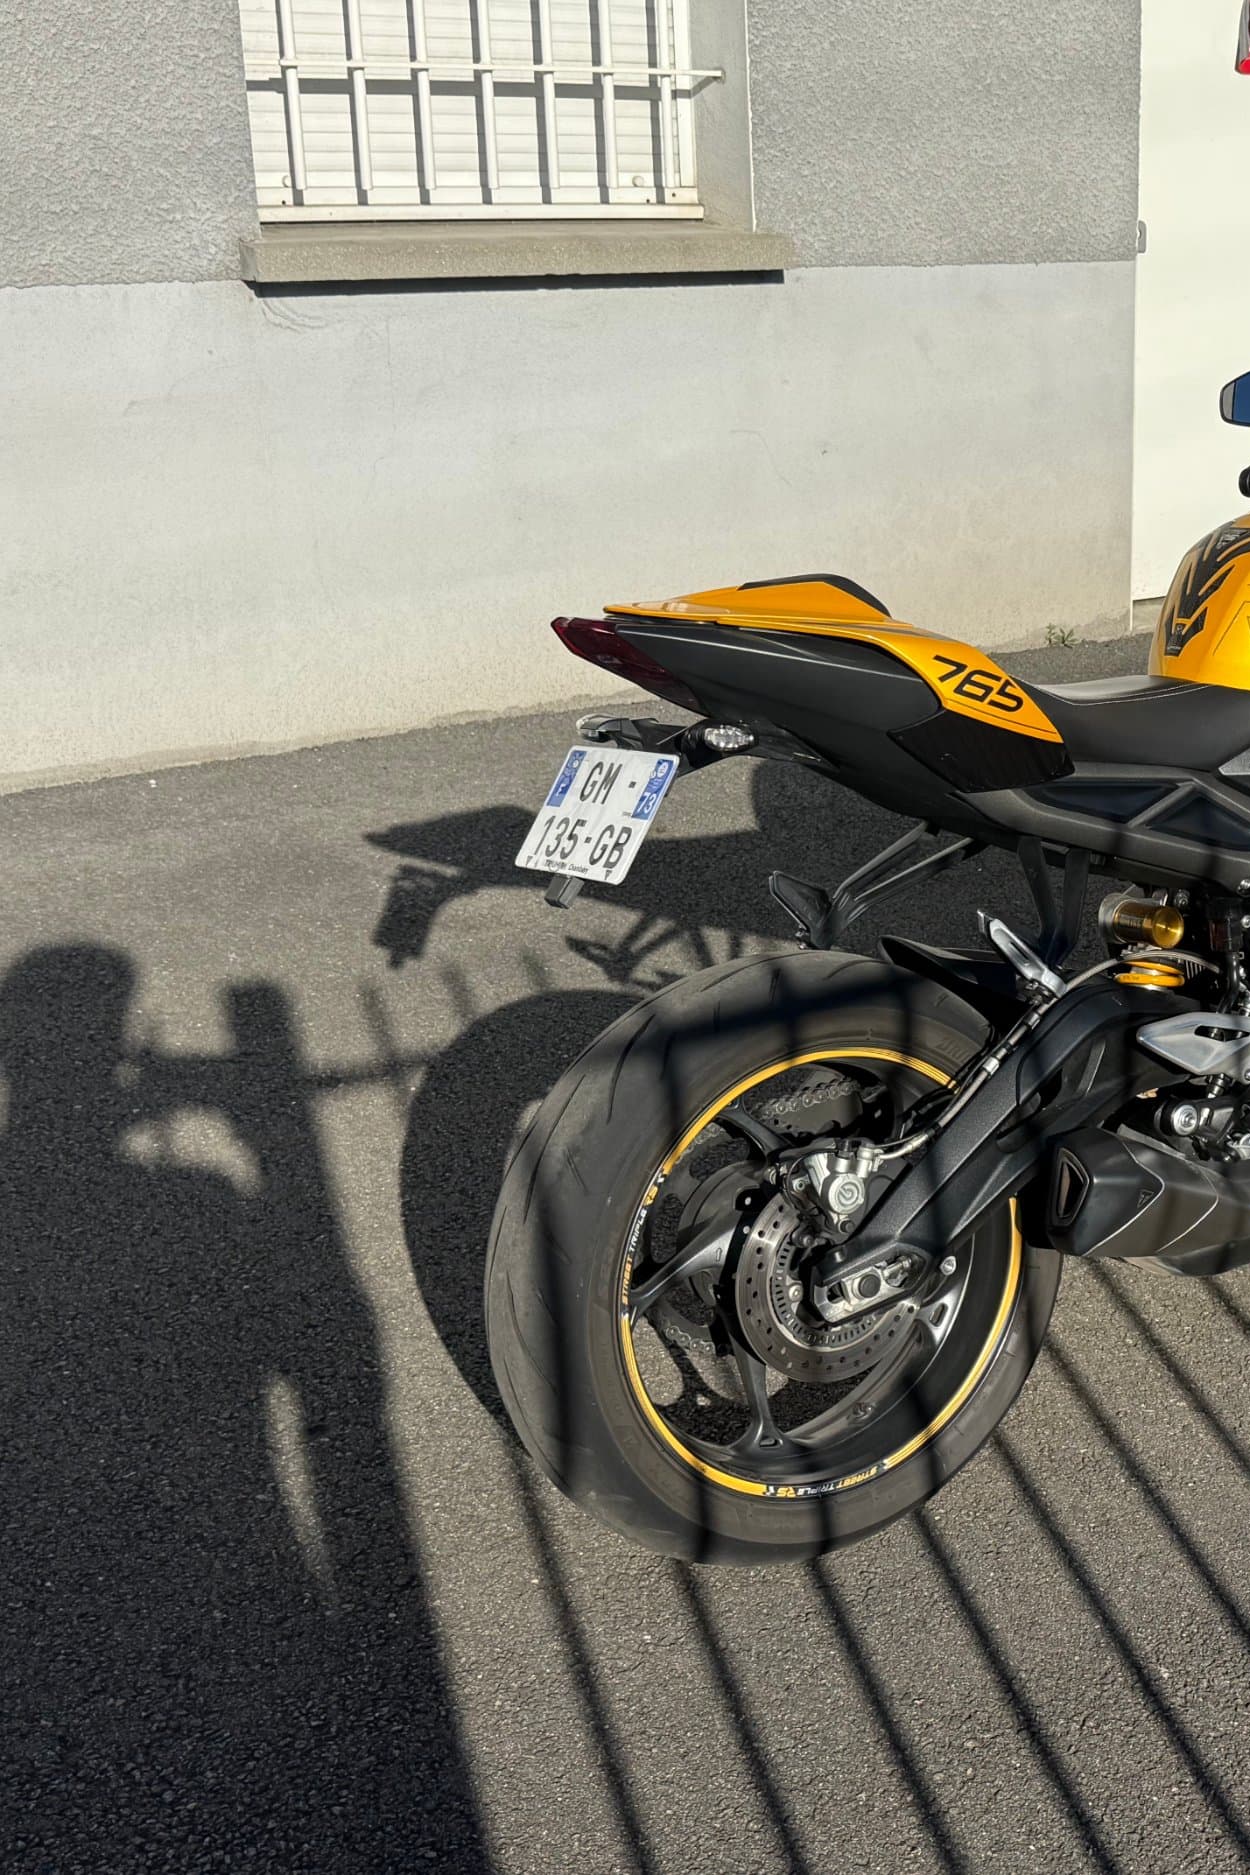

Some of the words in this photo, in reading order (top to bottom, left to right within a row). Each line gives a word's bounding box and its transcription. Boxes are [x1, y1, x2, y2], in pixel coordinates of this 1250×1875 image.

[933, 654, 1024, 713] 765
[637, 791, 657, 815] 73
[534, 815, 633, 870] 135-GB
[629, 1210, 648, 1252] TRIPLE
[776, 1487, 797, 1498] RS
